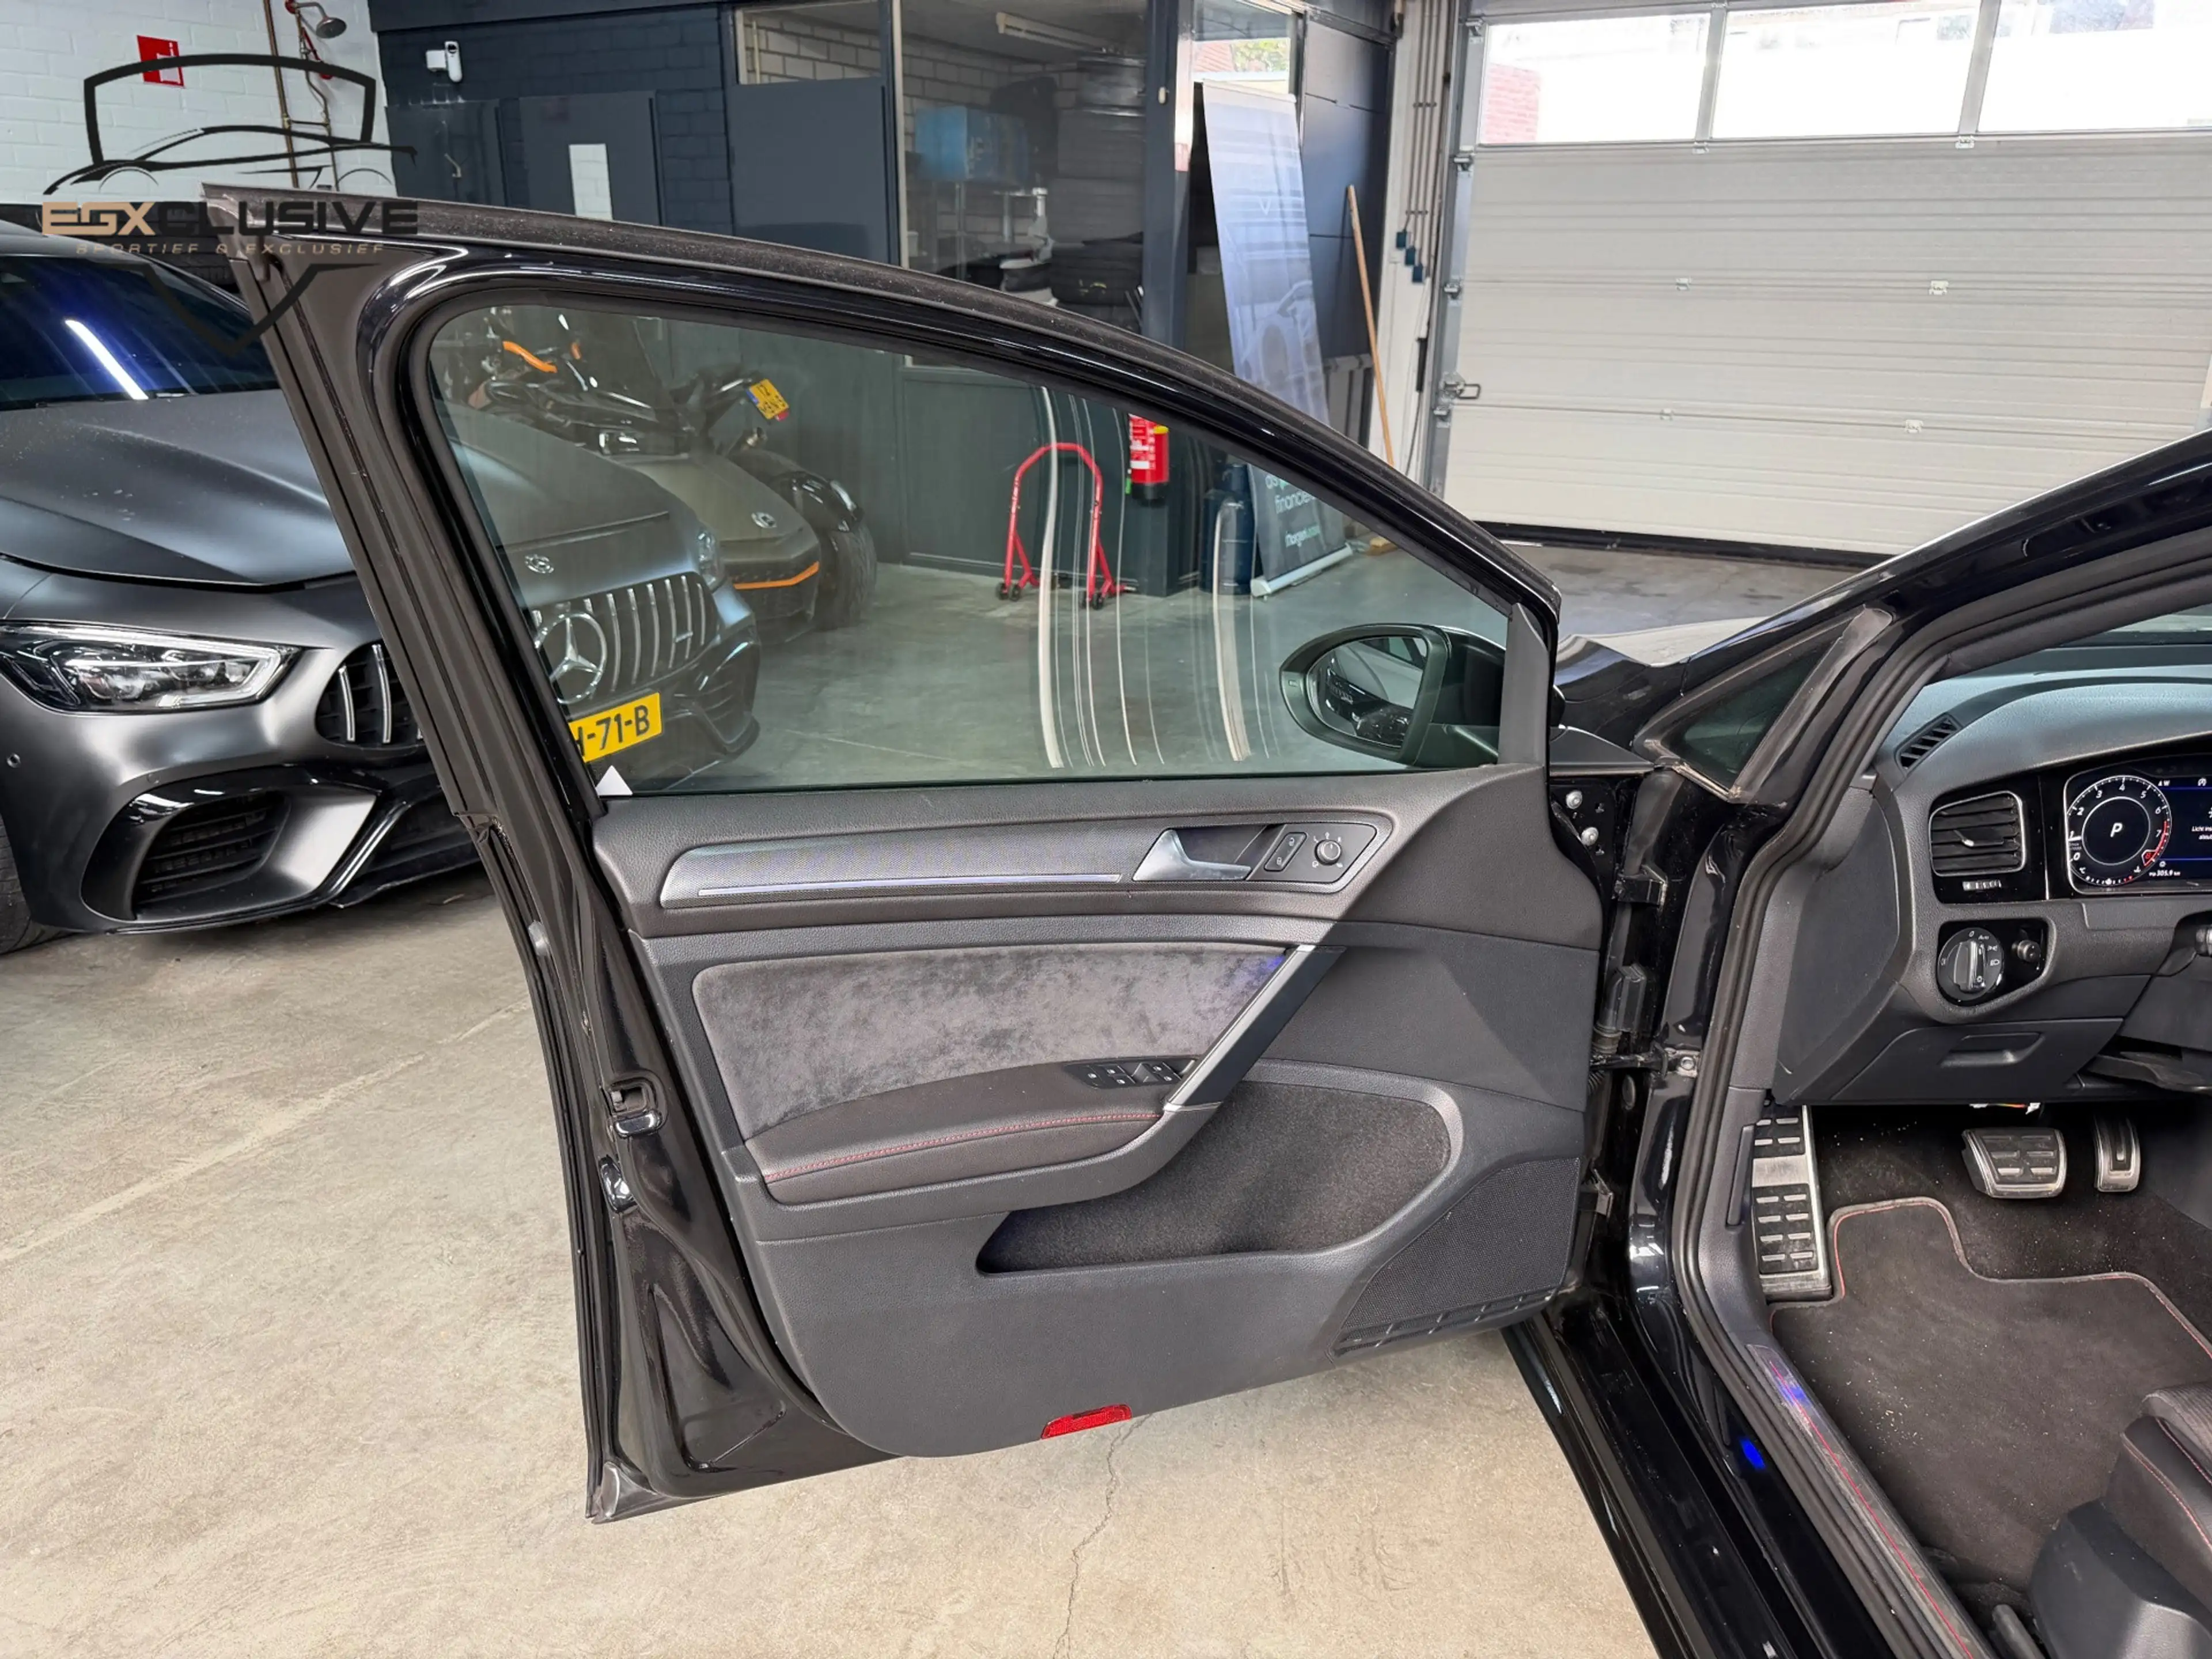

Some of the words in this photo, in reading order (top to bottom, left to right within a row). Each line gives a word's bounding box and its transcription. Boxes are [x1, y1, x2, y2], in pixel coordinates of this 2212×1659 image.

[2096, 790, 2103, 798] 3
[2141, 791, 2147, 799] 5
[2077, 807, 2084, 816] 2
[2155, 806, 2161, 814] 6
[2110, 822, 2123, 837] P
[2074, 853, 2081, 861] 0
